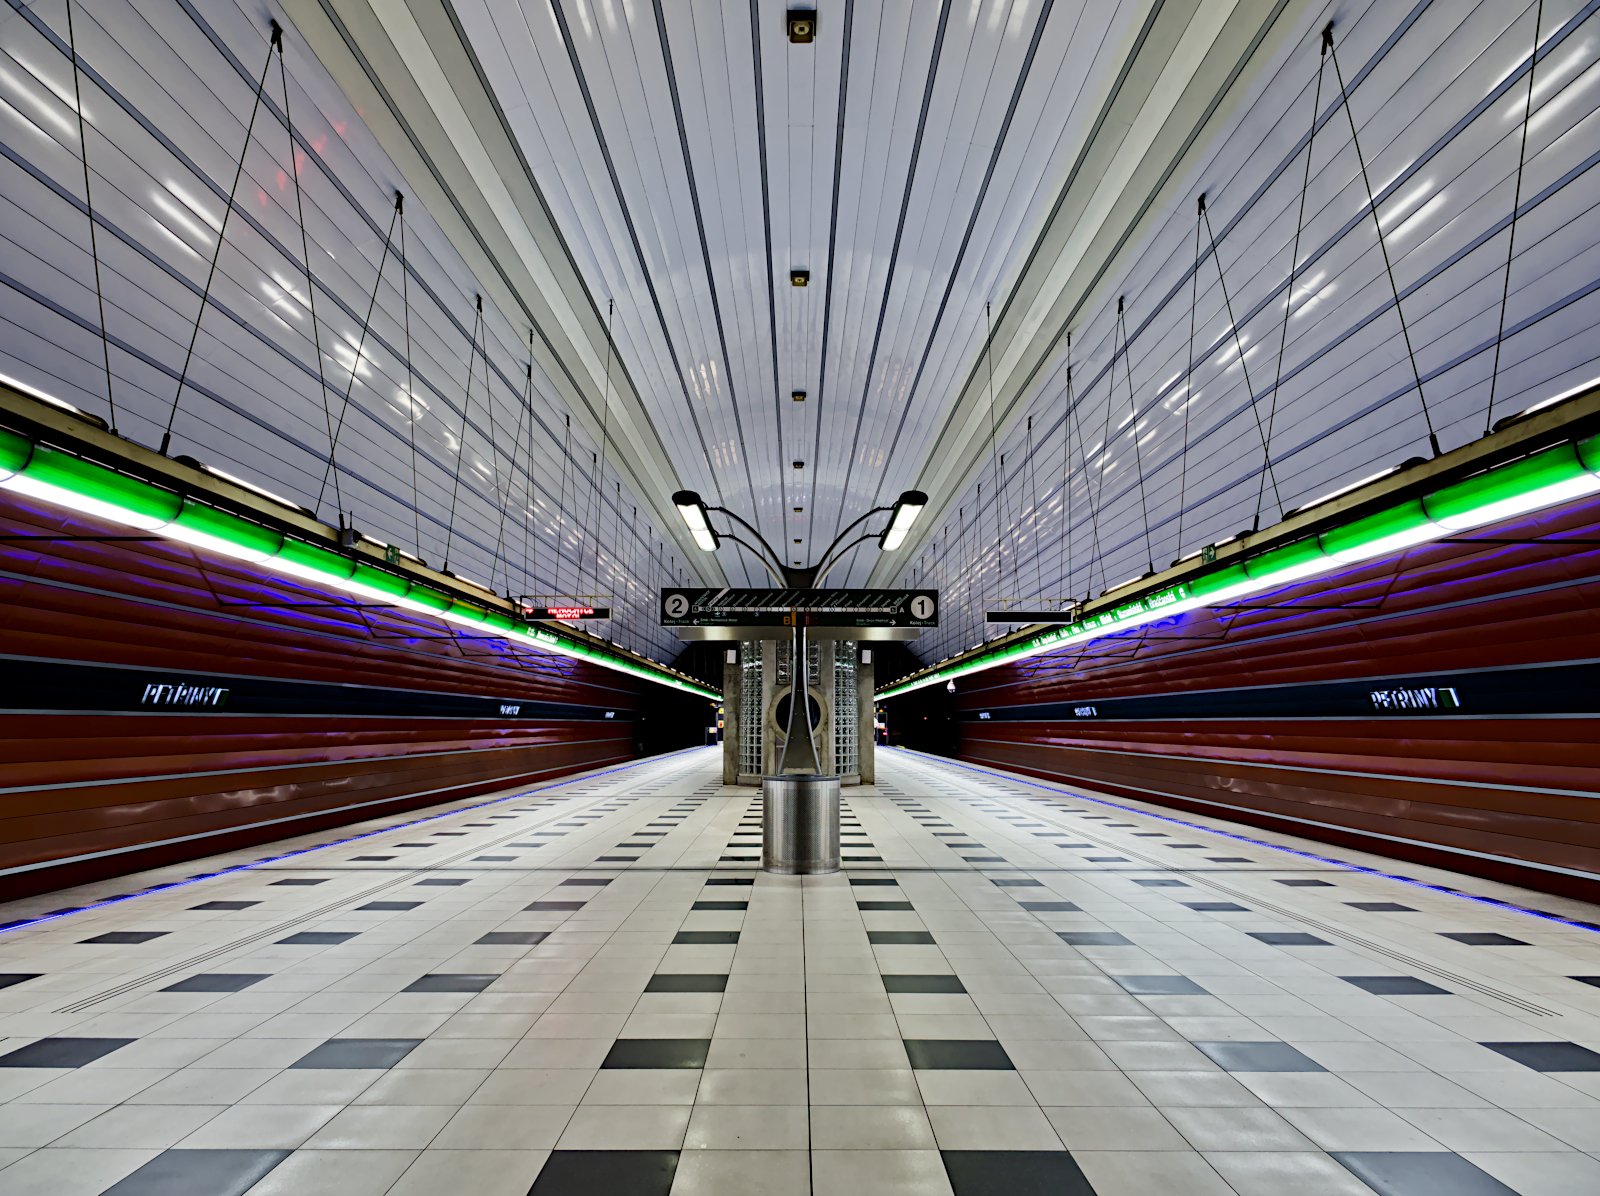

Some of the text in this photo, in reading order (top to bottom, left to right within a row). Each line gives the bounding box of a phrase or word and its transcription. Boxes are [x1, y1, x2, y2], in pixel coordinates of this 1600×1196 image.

[671, 598, 683, 614] 2
[917, 599, 926, 616] 1
[783, 616, 791, 625] B
